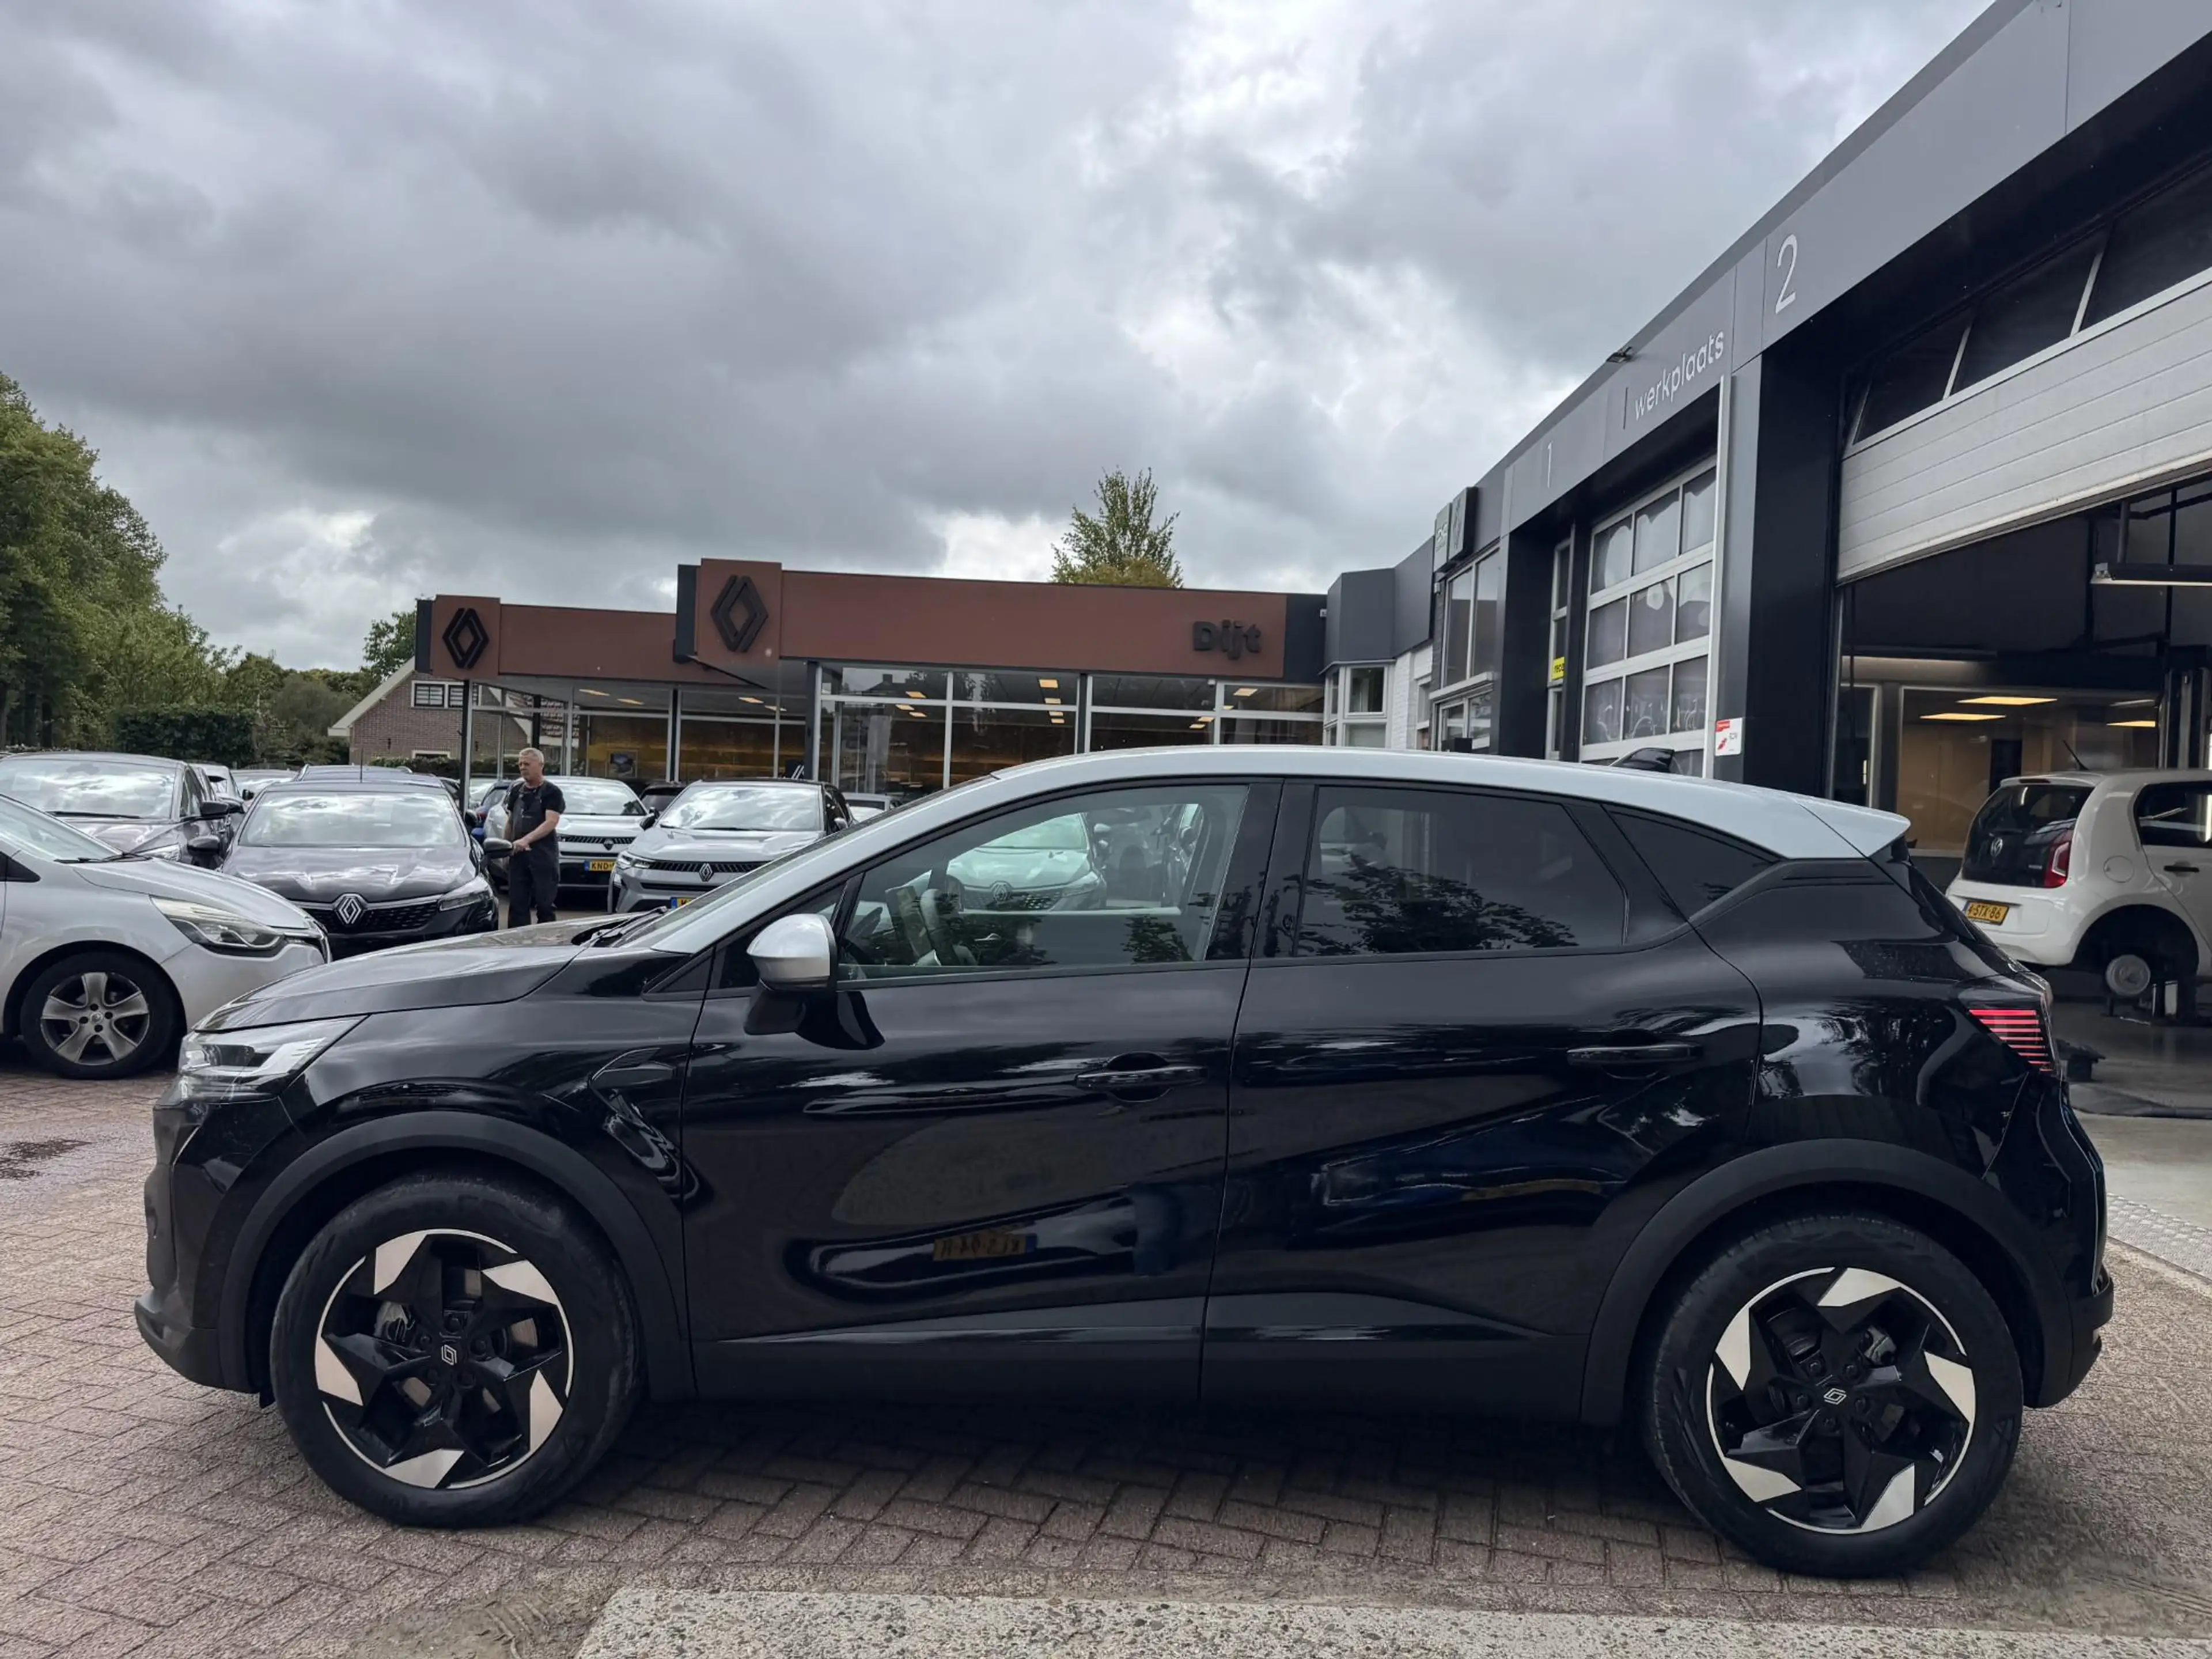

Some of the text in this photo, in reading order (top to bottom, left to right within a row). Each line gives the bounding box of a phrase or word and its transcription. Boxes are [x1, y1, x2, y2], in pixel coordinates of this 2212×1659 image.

[1775, 234, 1798, 314] 2
[1635, 331, 1724, 421] werkplaats
[1192, 619, 1262, 661] Dijt
